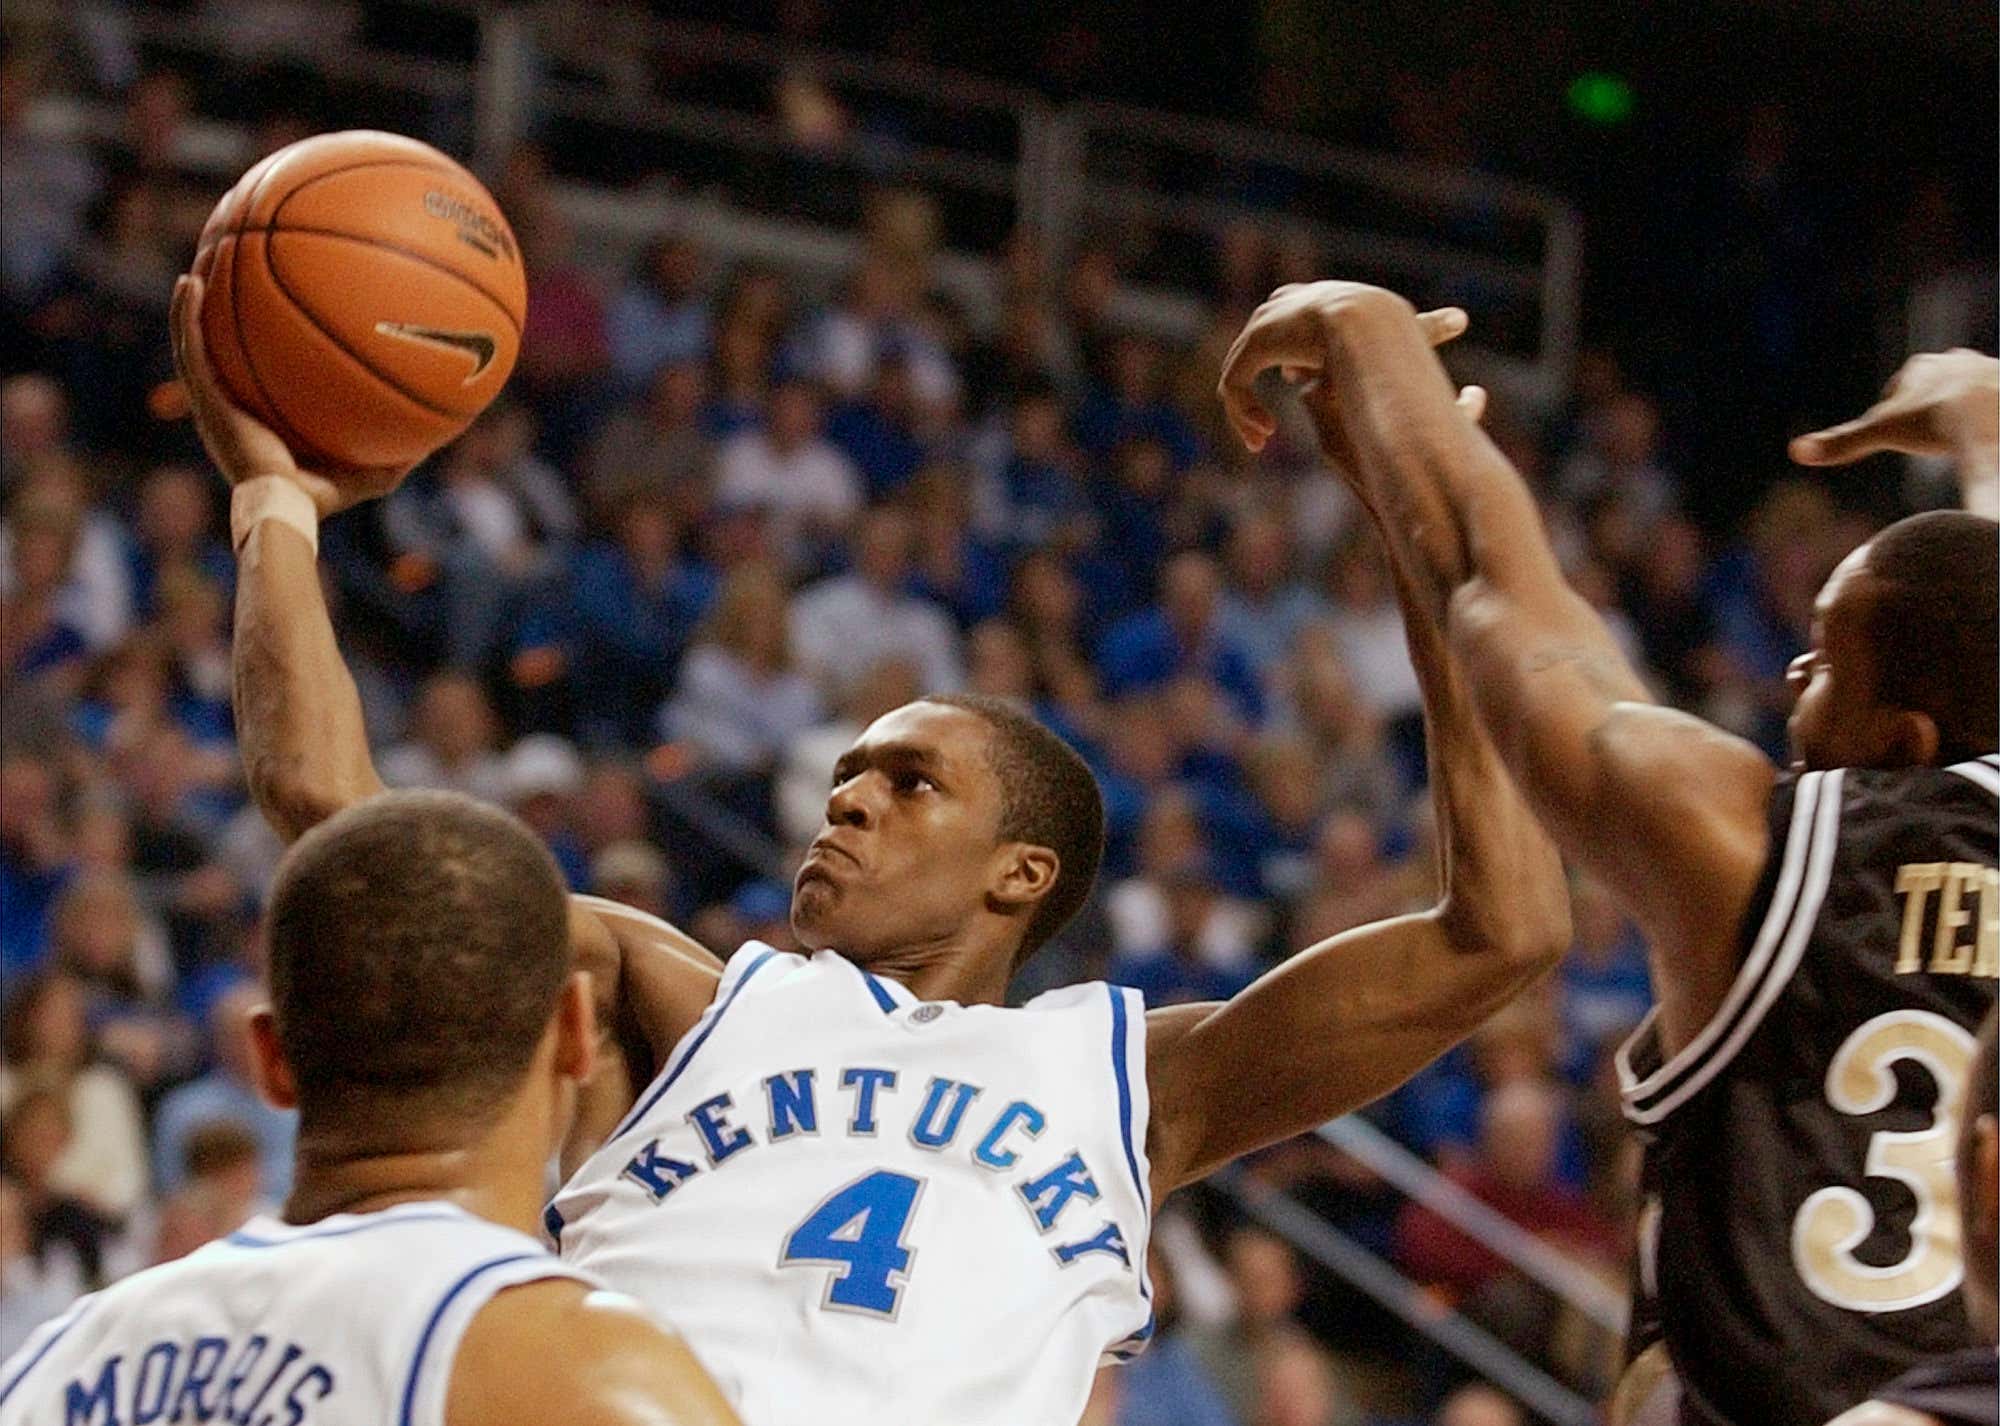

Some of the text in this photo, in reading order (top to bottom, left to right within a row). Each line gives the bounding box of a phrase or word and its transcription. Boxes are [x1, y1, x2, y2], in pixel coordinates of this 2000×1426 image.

[619, 1067, 1132, 1272] KENTUCKY
[777, 1166, 929, 1322] 4
[1791, 1009, 1981, 1314] 3
[64, 1333, 334, 1426] MORRIS
